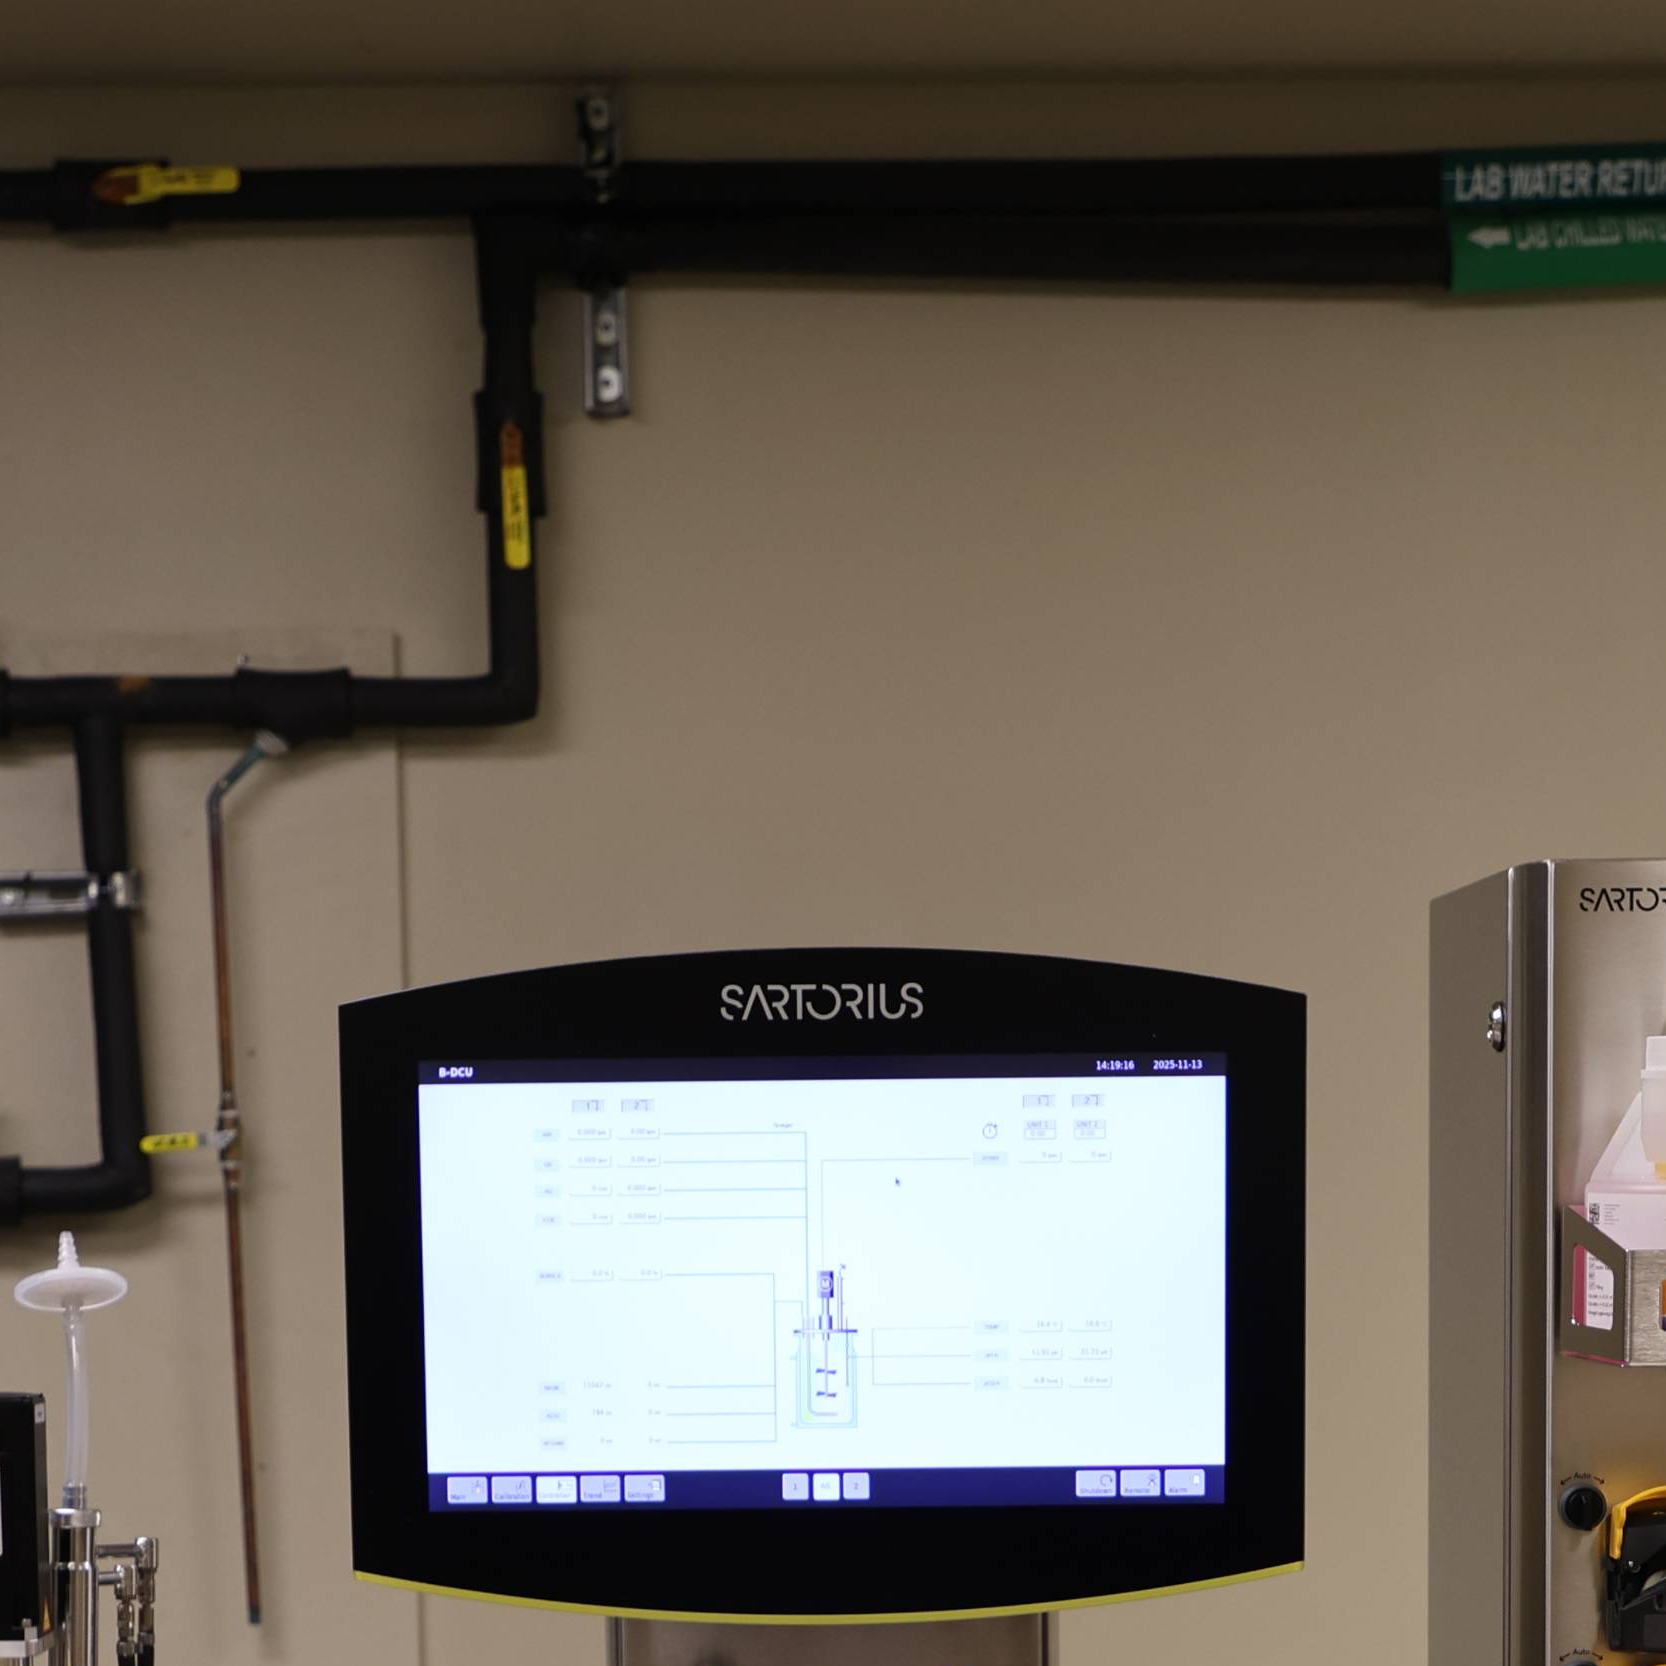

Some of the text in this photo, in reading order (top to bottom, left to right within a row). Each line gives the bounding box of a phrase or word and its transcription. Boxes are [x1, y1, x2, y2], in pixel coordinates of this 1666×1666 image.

[1454, 163, 1504, 201] LAB
[1508, 160, 1593, 199] WATER
[720, 981, 924, 1021] SARTORIUS
[438, 1066, 474, 1079] B-DCU
[1096, 1058, 1203, 1071] 14:19:16 2025-11-13
